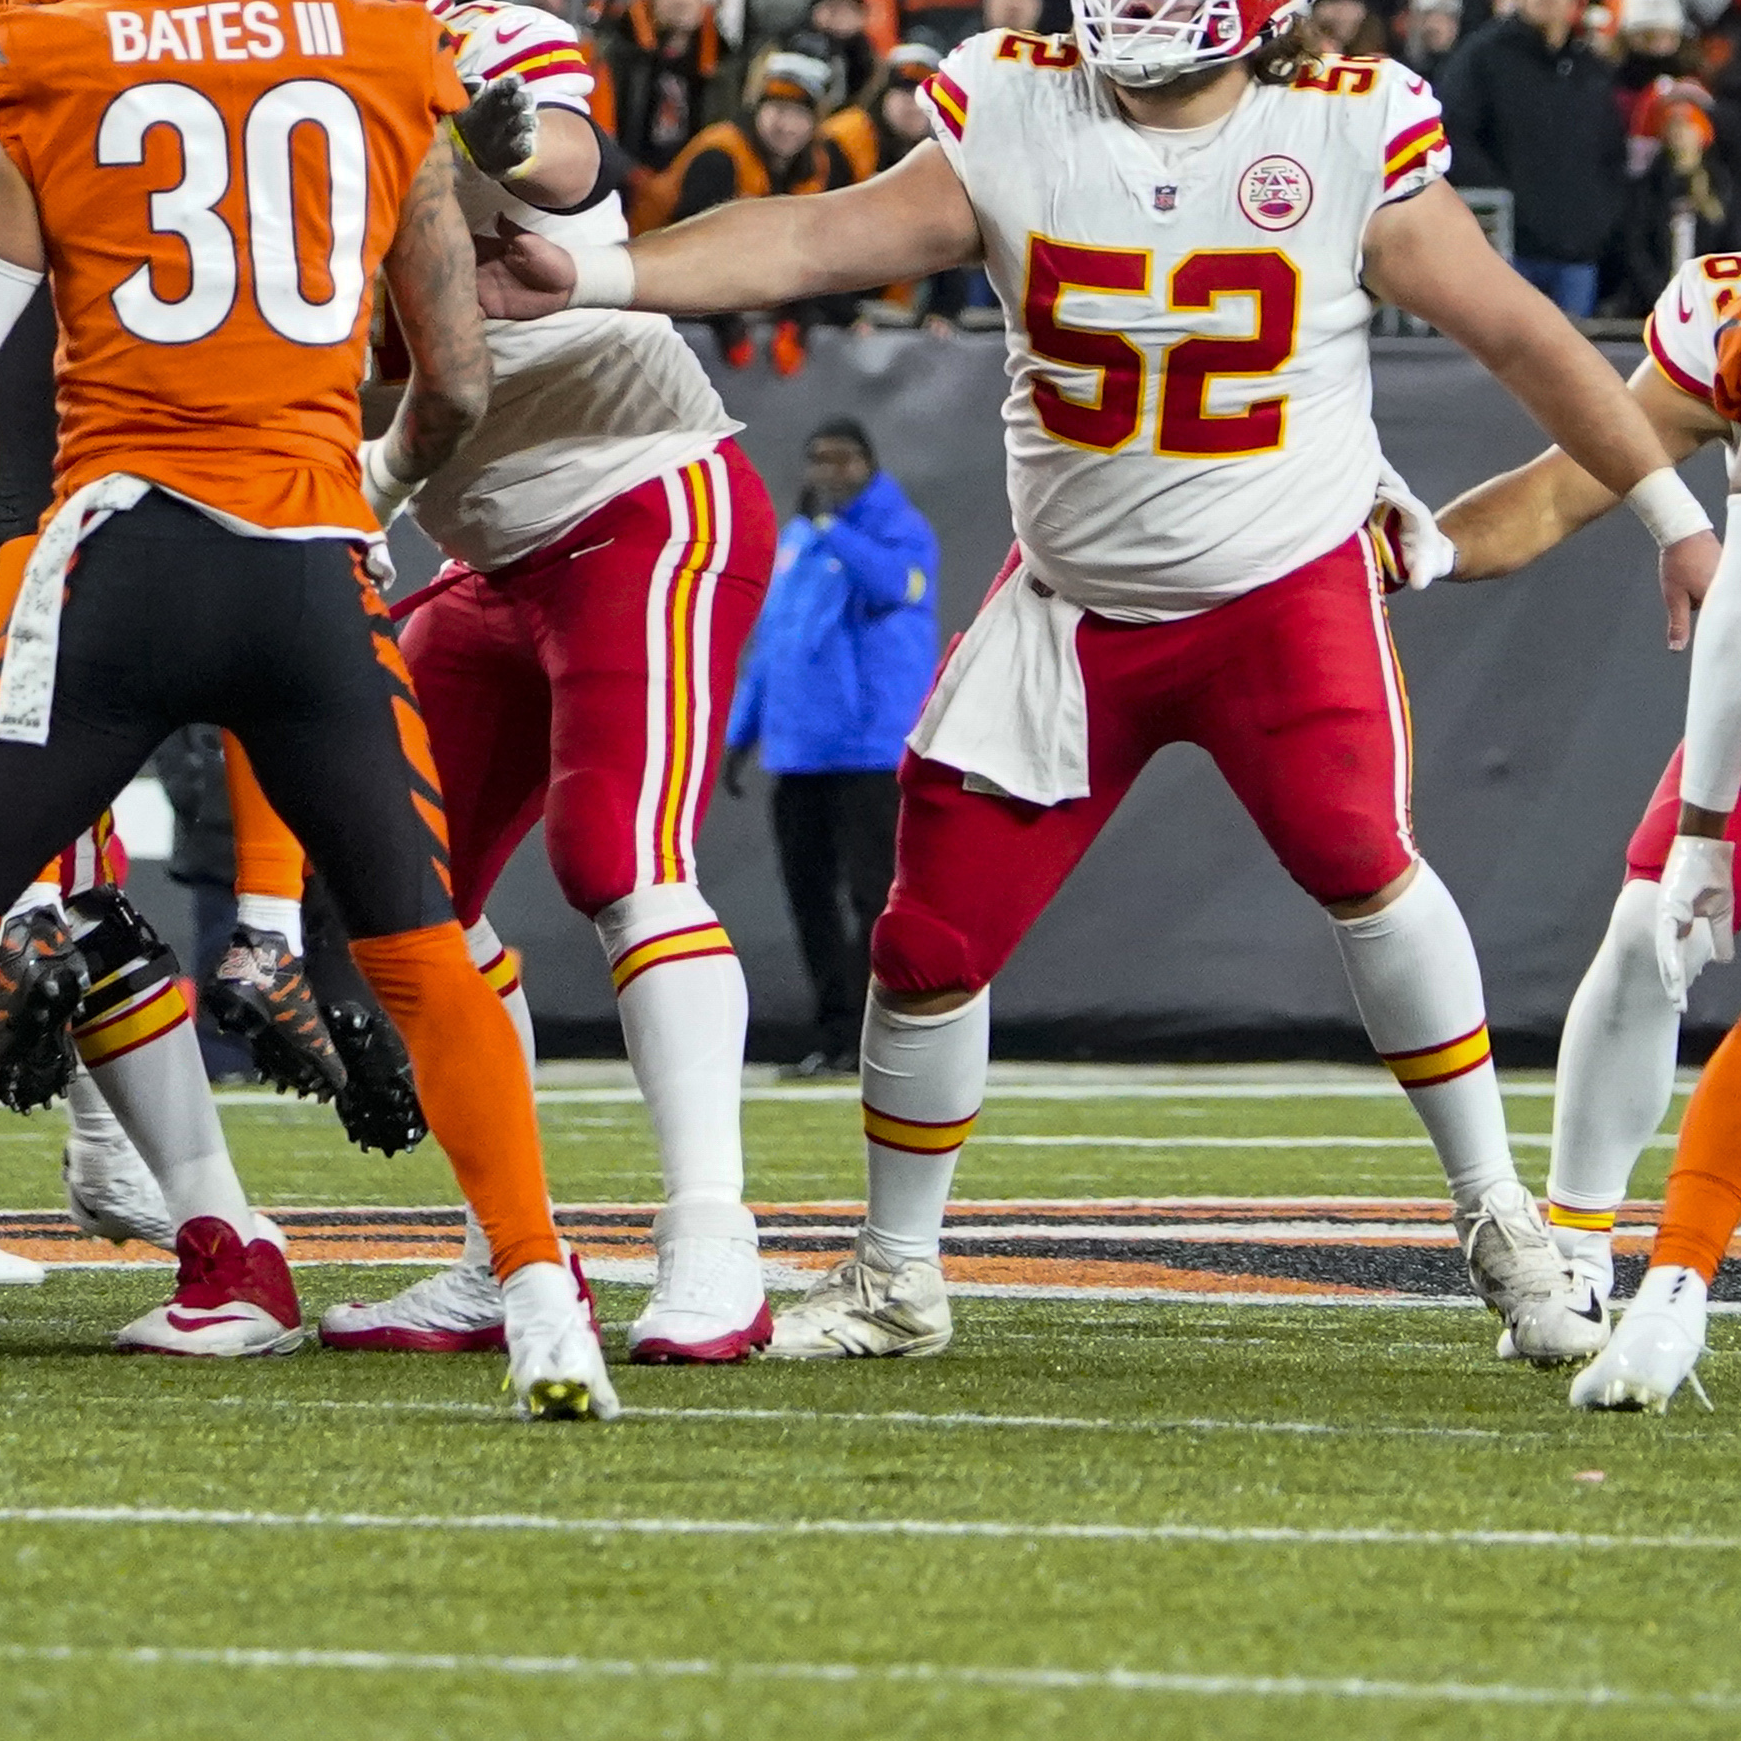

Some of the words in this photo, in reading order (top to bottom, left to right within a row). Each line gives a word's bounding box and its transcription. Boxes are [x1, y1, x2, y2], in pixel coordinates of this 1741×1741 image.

[106, 0, 286, 62] BATES
[291, 1, 344, 56] III
[95, 77, 369, 347] 30
[1023, 231, 1302, 458] 52
